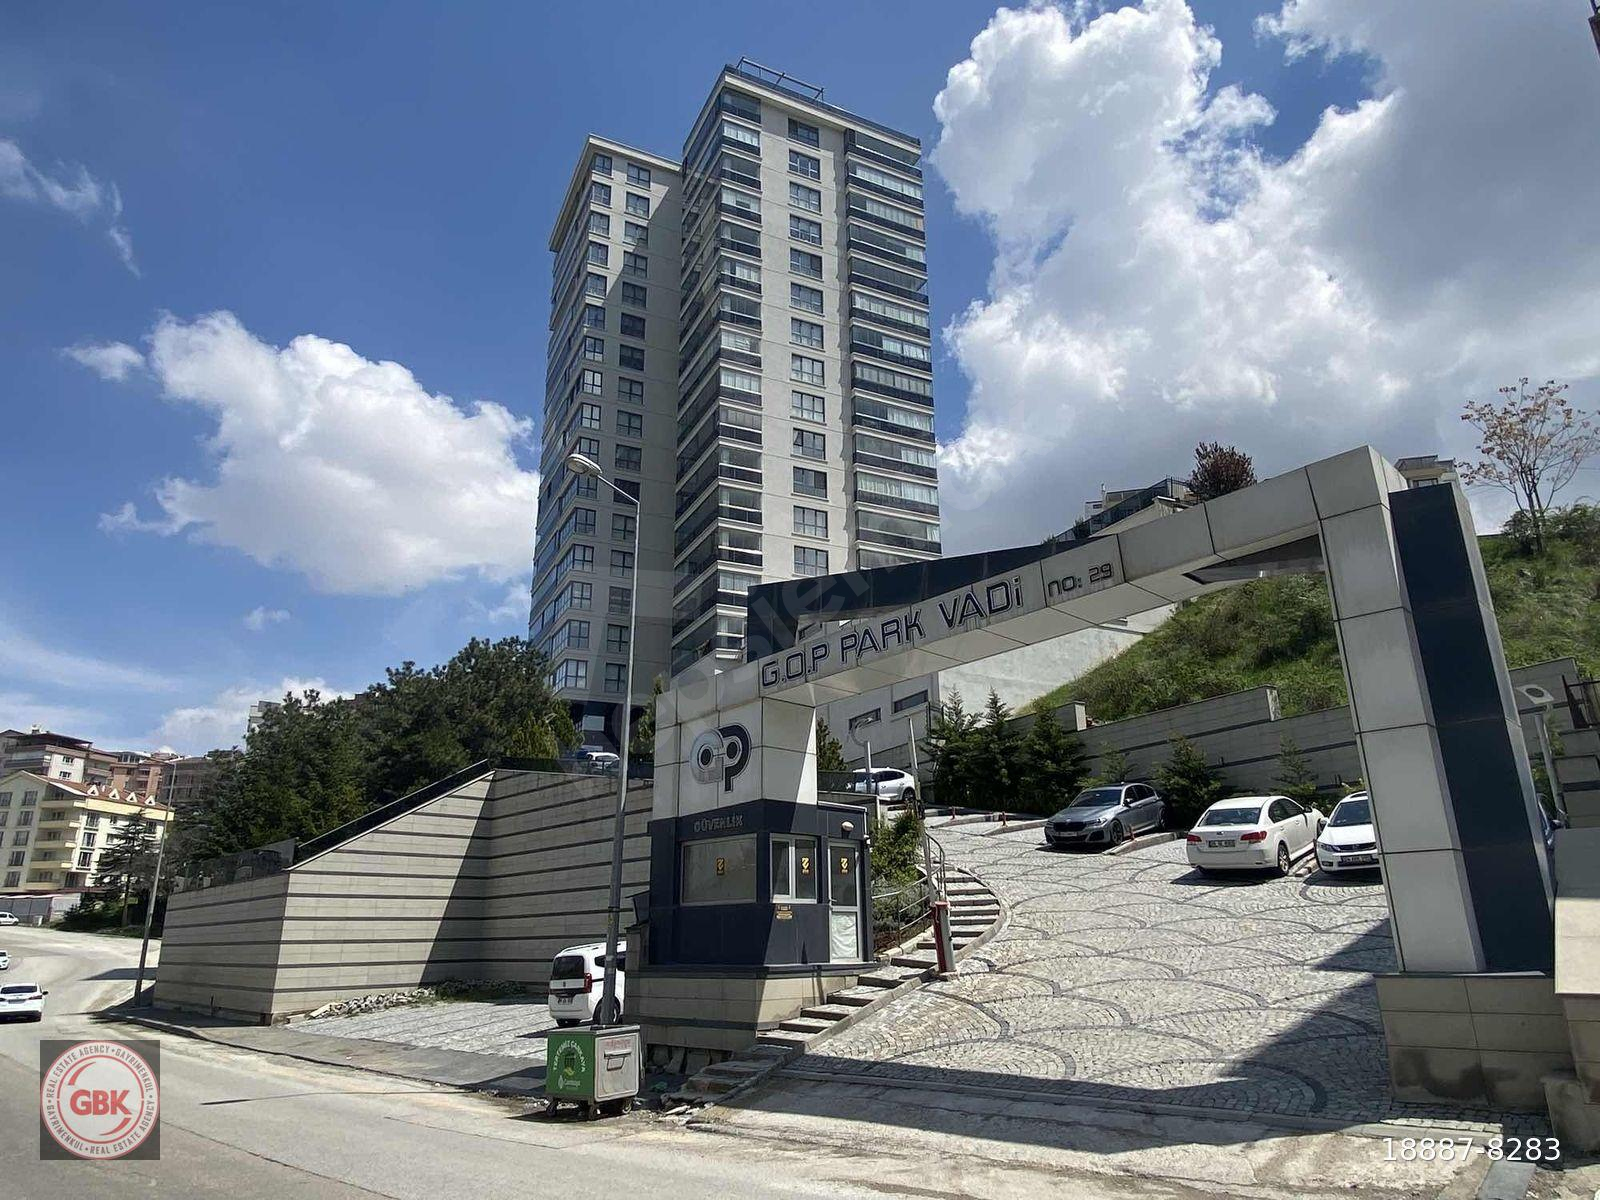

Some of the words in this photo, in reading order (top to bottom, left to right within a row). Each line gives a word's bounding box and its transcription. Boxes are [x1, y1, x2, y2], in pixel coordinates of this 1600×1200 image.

[761, 642, 829, 688] G.O.P
[840, 609, 926, 664] PARK
[1088, 562, 1113, 584] 29
